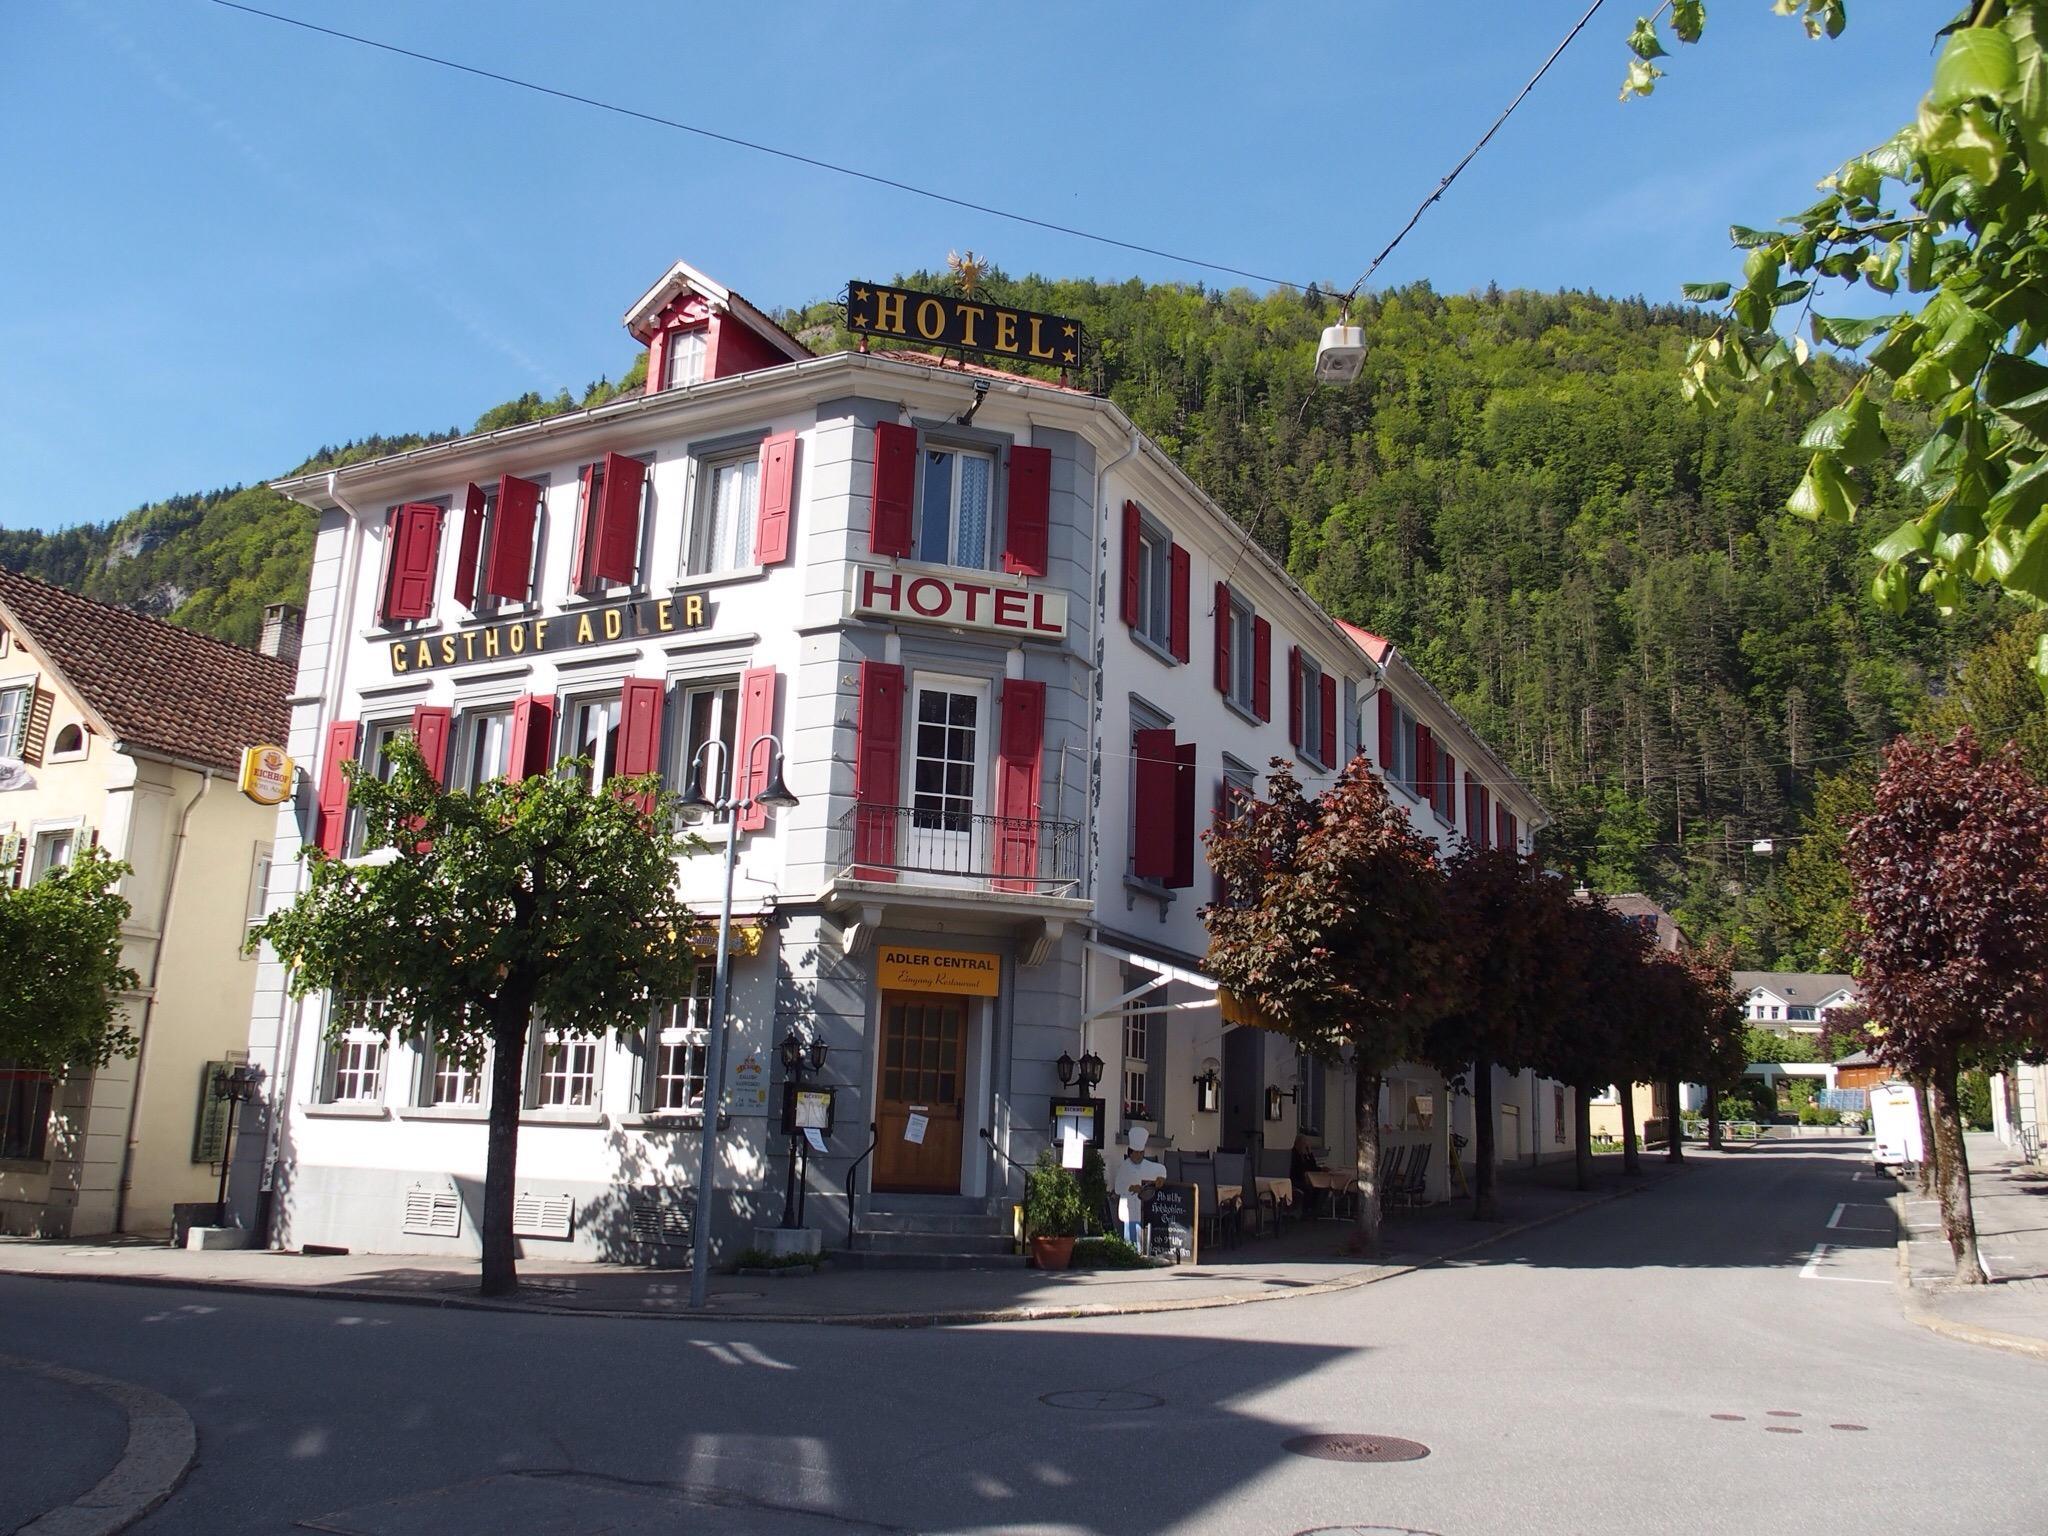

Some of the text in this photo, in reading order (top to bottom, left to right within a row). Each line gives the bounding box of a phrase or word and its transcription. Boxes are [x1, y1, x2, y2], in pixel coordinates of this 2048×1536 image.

[875, 291, 1054, 359] HOTEL
[863, 570, 1062, 632] HOTEL
[393, 595, 704, 671] GASTHOF ADLER
[253, 768, 289, 783] EICHHOF
[885, 953, 995, 971] ADLER CENTRAL
[897, 970, 980, 988] Eingang Restaurant
